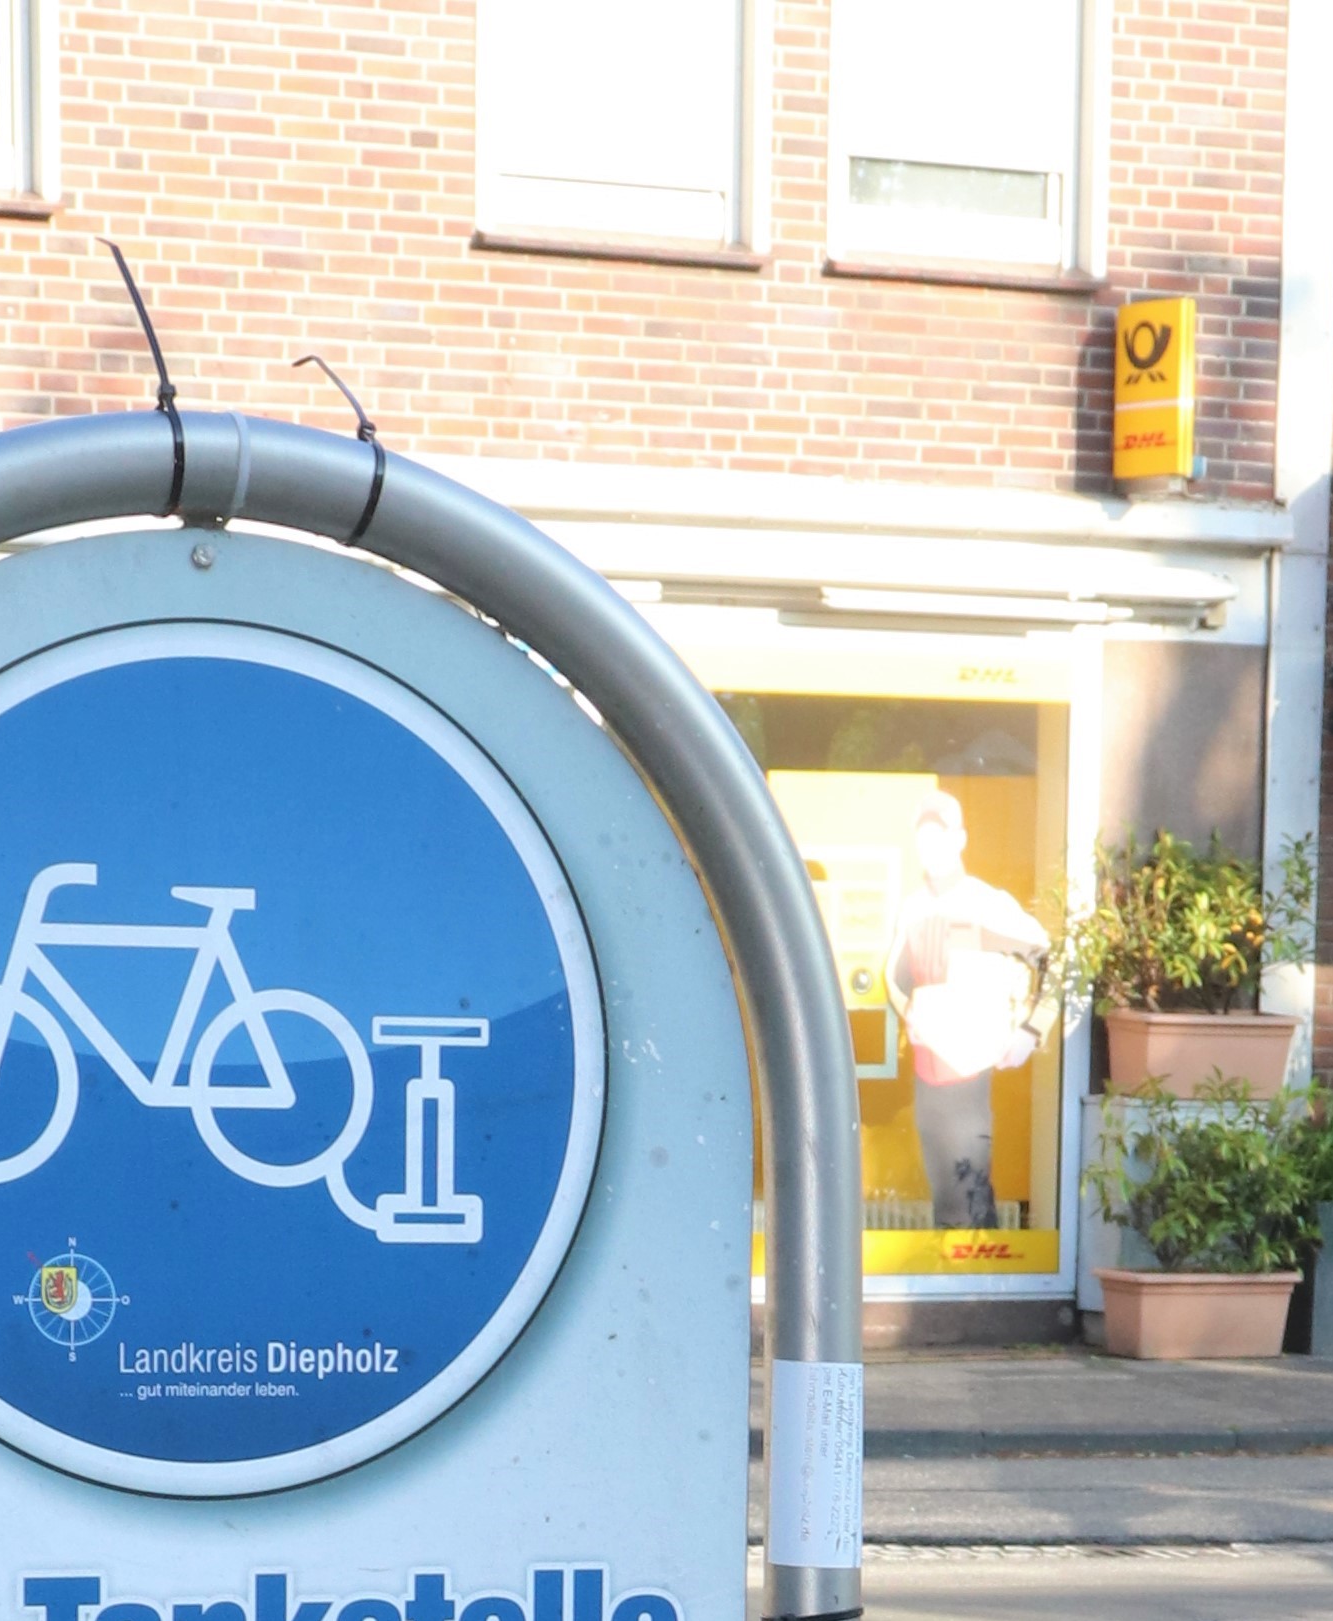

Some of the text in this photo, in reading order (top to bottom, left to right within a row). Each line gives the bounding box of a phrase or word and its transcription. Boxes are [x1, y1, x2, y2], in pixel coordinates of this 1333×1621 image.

[1123, 430, 1165, 451] DHL
[67, 1237, 77, 1247] N
[951, 1244, 1012, 1259] DHL
[12, 1295, 25, 1305] W
[68, 1351, 77, 1362] S
[118, 1341, 399, 1379] Landkreis Diepholz
[137, 1383, 162, 1399] gut
[165, 1381, 251, 1397] miteinander
[255, 1381, 299, 1397] leben.
[820, 1389, 833, 1425] E-Mail
[820, 1428, 830, 1458] unter
